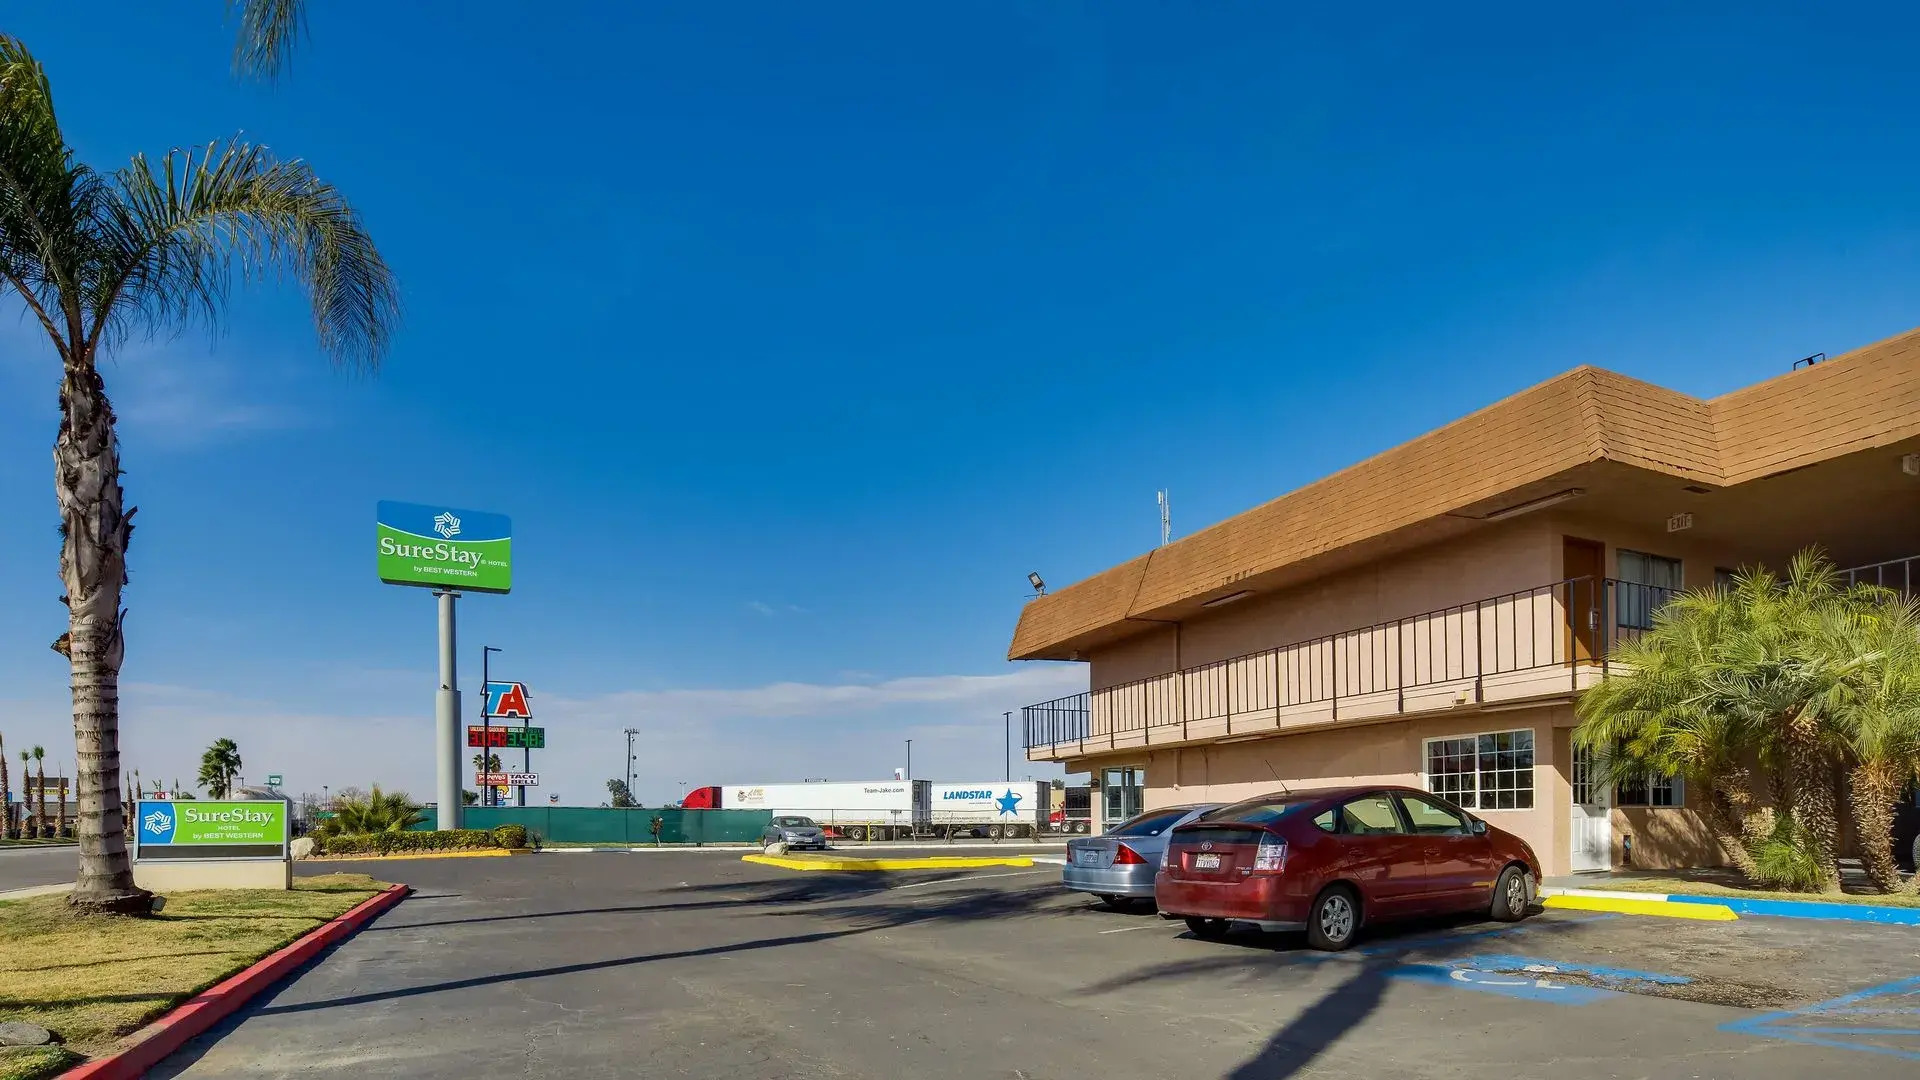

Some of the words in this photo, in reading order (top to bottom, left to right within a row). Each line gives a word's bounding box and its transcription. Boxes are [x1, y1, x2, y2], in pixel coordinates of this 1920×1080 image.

[1671, 514, 1688, 529] EXIT
[380, 537, 483, 569] SureStay
[413, 565, 423, 573] by
[423, 566, 443, 574] BEST
[443, 568, 478, 577] WESTERN
[481, 681, 532, 718] TA
[943, 790, 993, 800] LANDSTAR
[185, 808, 273, 827] SureStay
